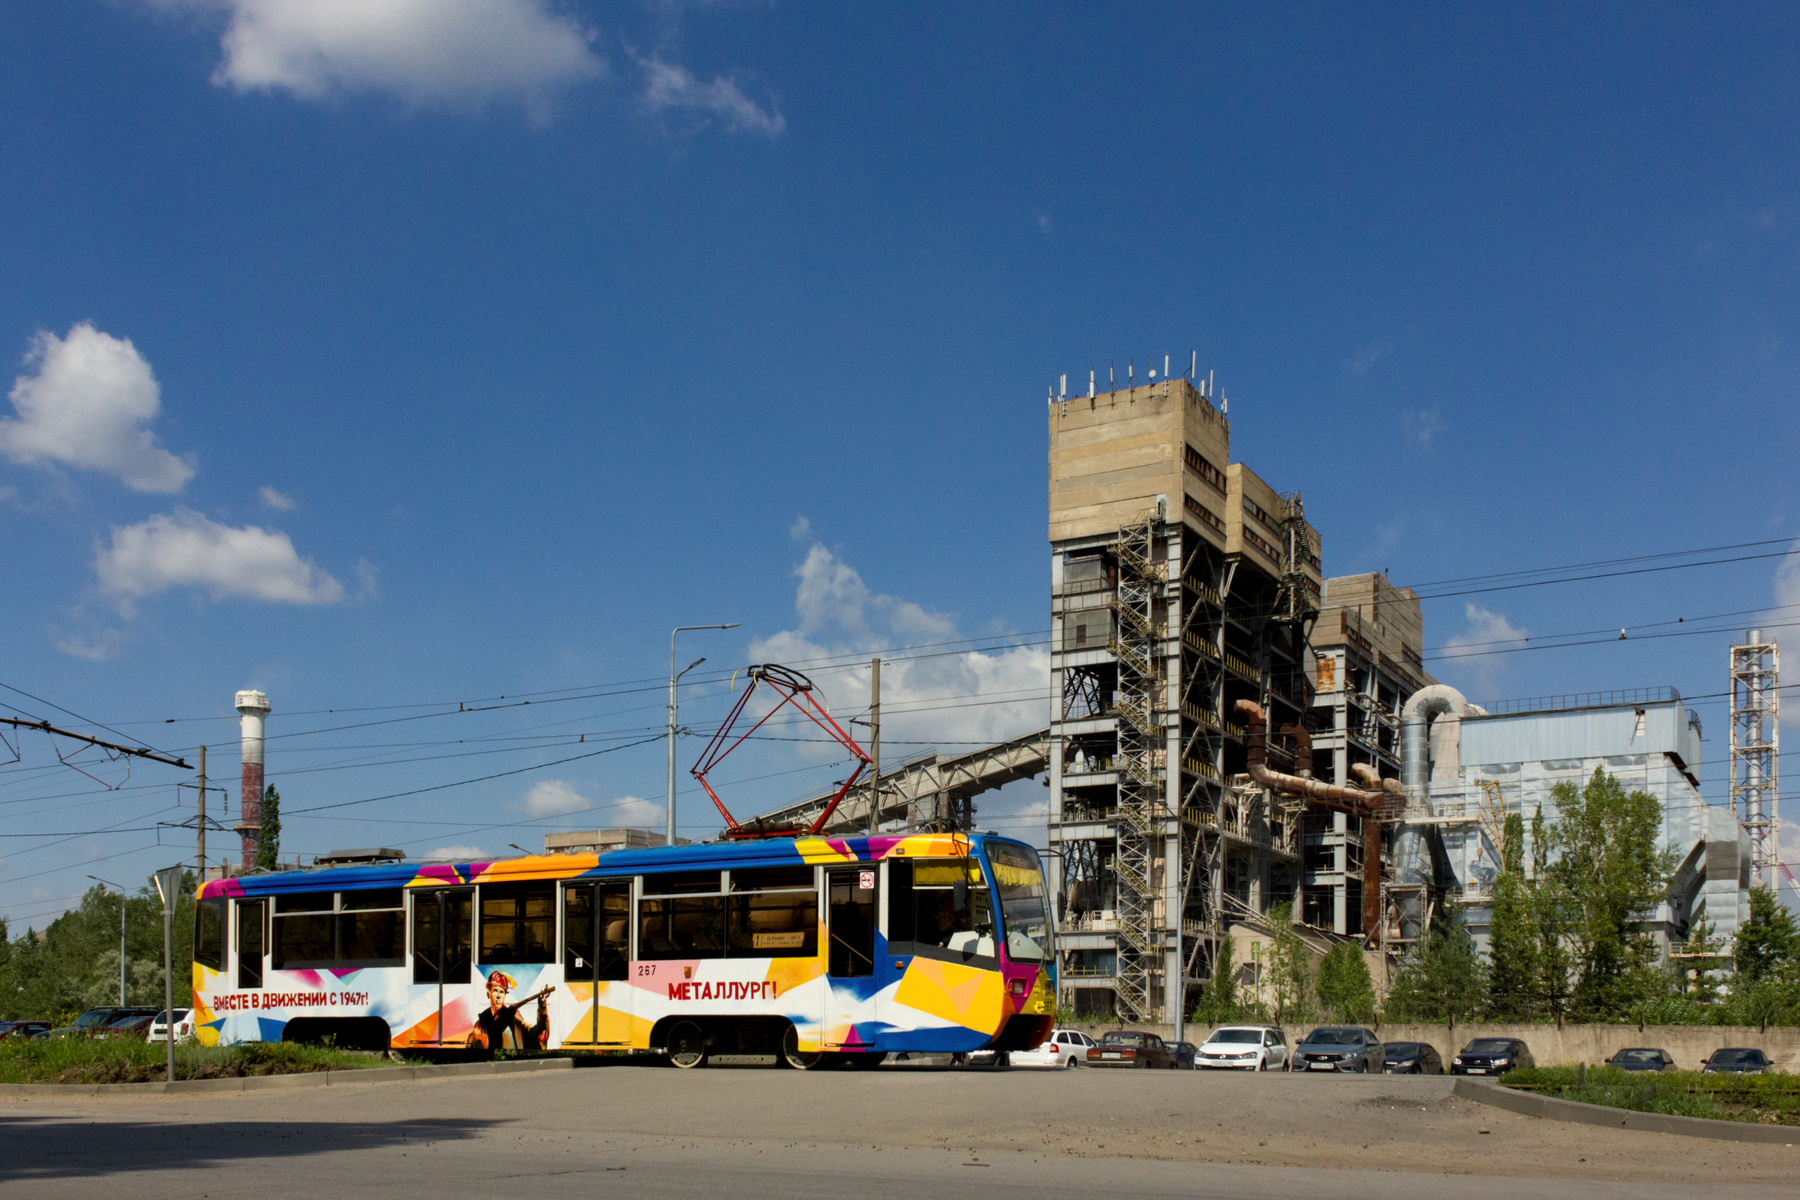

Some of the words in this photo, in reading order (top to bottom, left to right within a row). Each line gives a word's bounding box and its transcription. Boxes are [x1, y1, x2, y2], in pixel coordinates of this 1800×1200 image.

[638, 965, 657, 976] 267
[668, 981, 777, 1000] МЕТАЛЛУРГ!
[213, 994, 250, 1011] ВМЕСТЕ
[251, 993, 260, 1008] В
[261, 992, 328, 1010] ДВИЖЕНИИ
[329, 992, 337, 1006] С
[340, 991, 369, 1006] 1947г!
